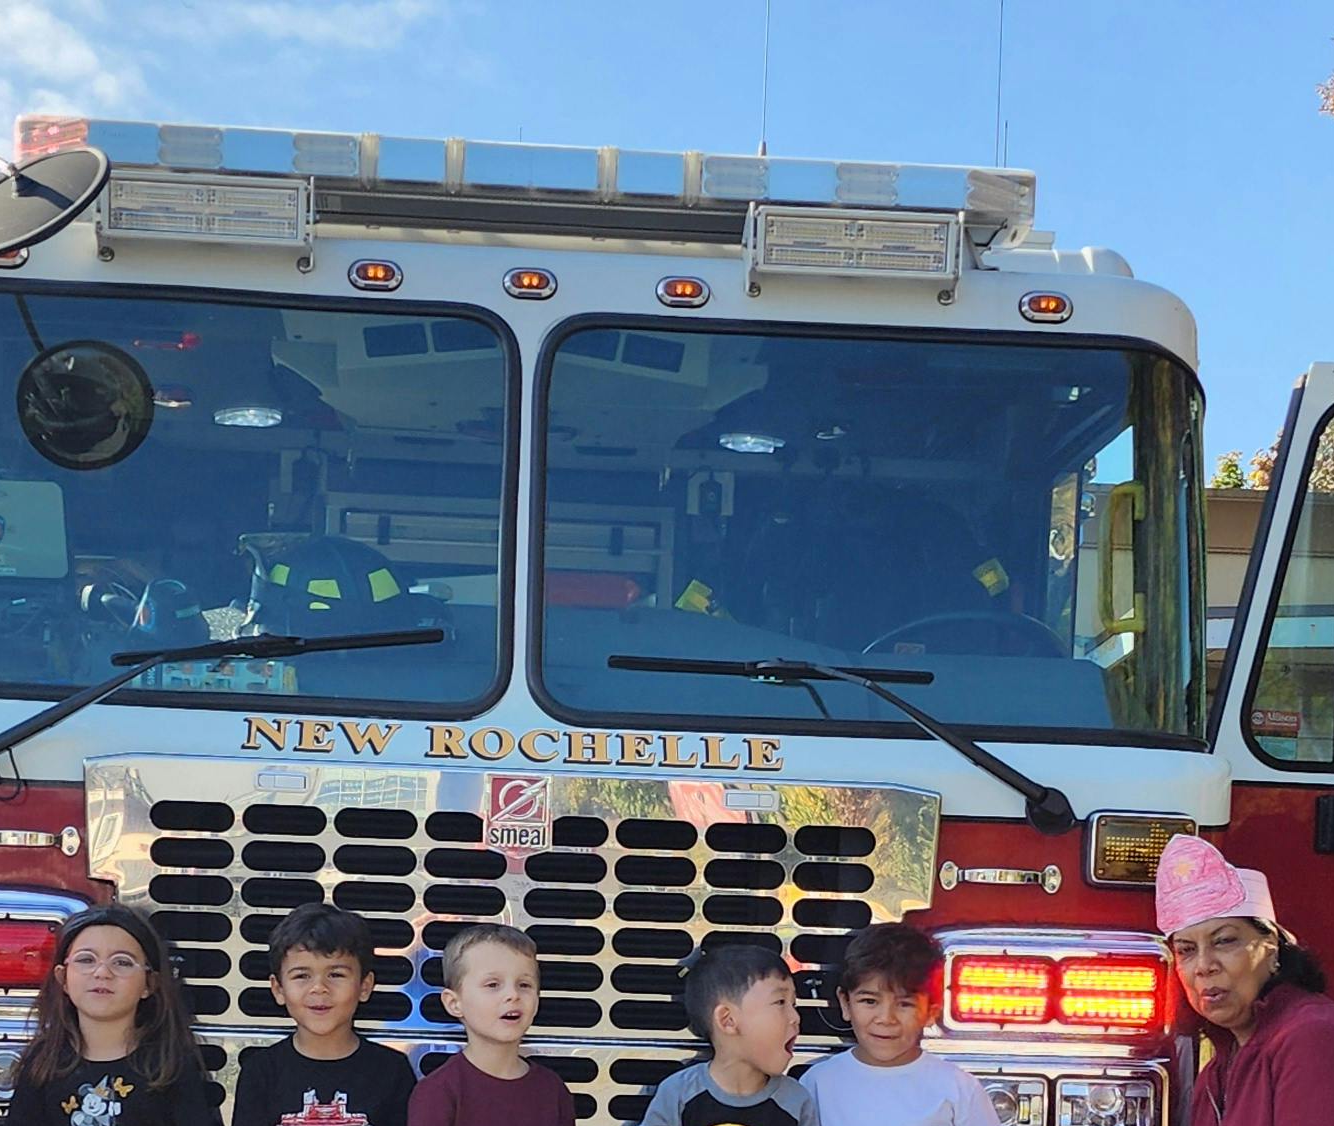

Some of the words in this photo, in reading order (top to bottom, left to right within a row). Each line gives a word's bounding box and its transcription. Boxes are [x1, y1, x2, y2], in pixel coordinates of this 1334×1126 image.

[241, 716, 403, 755] NEW
[424, 725, 785, 771] ROCHELLE
[490, 827, 546, 846] smeal
